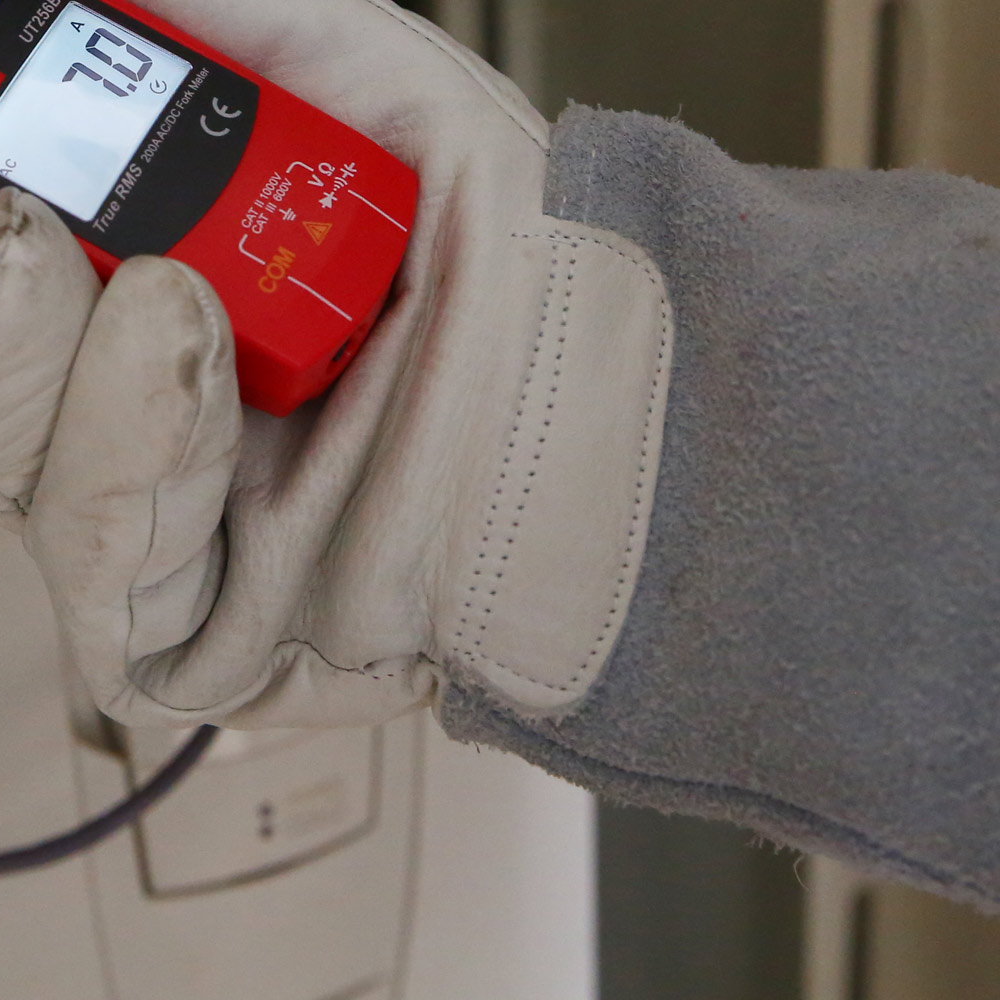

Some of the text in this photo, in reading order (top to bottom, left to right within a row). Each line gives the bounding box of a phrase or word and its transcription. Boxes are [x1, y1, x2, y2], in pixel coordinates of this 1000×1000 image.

[70, 21, 85, 32] A
[62, 27, 153, 98] 7.0
[0, 158, 18, 176] AC
[92, 200, 121, 233] True
[115, 163, 143, 200] RMS
[175, 91, 195, 111] Fork
[188, 67, 210, 92] Meter
[241, 206, 260, 229] CAT
[260, 171, 282, 200] 1000V
[251, 178, 293, 235] CAT III 600V
[258, 246, 296, 293] COM
